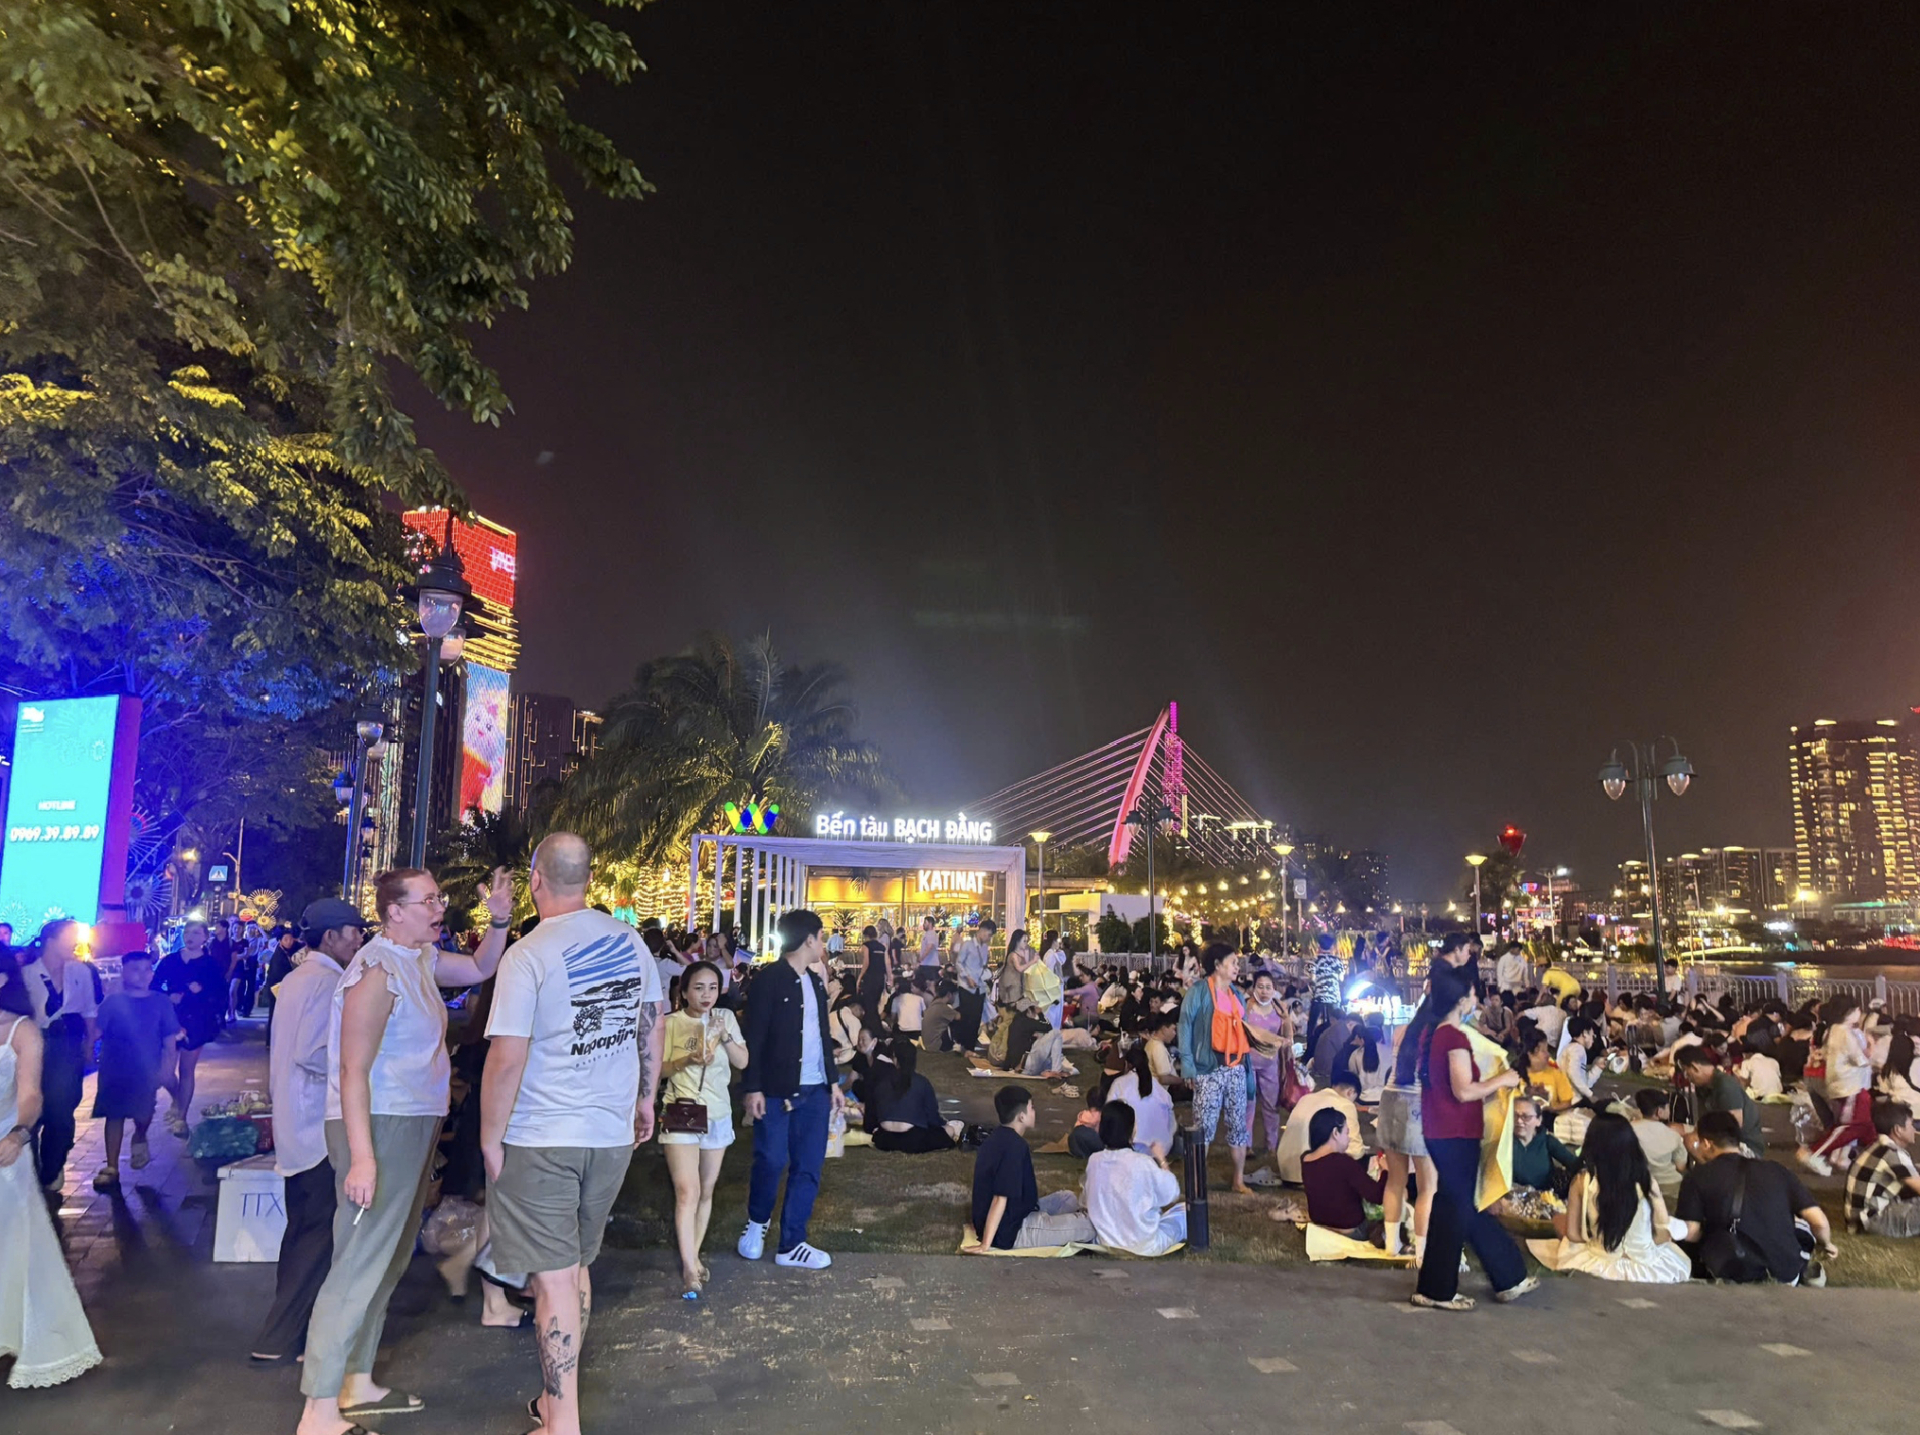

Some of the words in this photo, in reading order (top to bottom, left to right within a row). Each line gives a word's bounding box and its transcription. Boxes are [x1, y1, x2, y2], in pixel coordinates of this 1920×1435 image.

[816, 810, 856, 835] Bến
[860, 815, 888, 837] tàu
[894, 818, 940, 844] BẠCH
[945, 811, 992, 842] ĐẰNG
[918, 869, 986, 894] KATINAT
